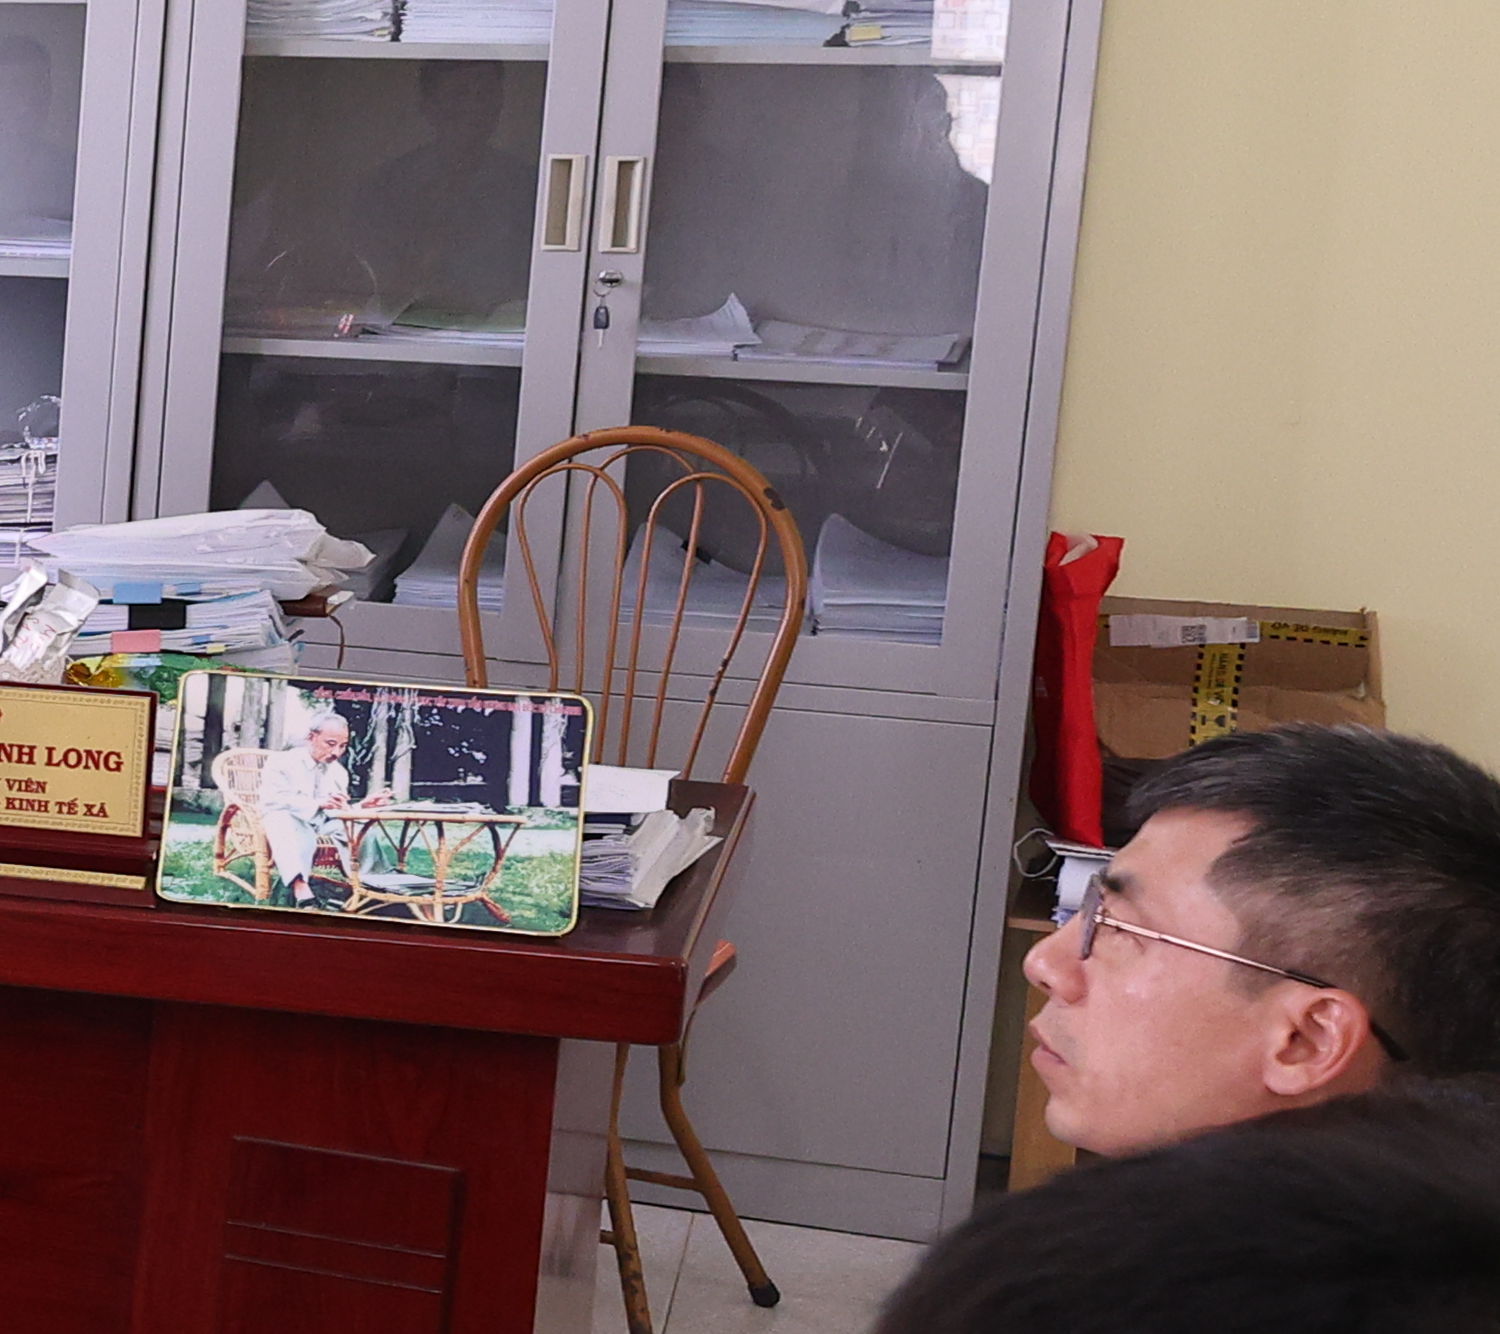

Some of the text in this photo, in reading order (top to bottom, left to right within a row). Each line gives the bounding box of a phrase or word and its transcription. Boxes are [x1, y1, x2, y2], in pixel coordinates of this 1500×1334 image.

[45, 746, 125, 773] LONG
[5, 776, 48, 795] VIÊN
[5, 797, 51, 813] KINH
[56, 798, 80, 816] TẾ
